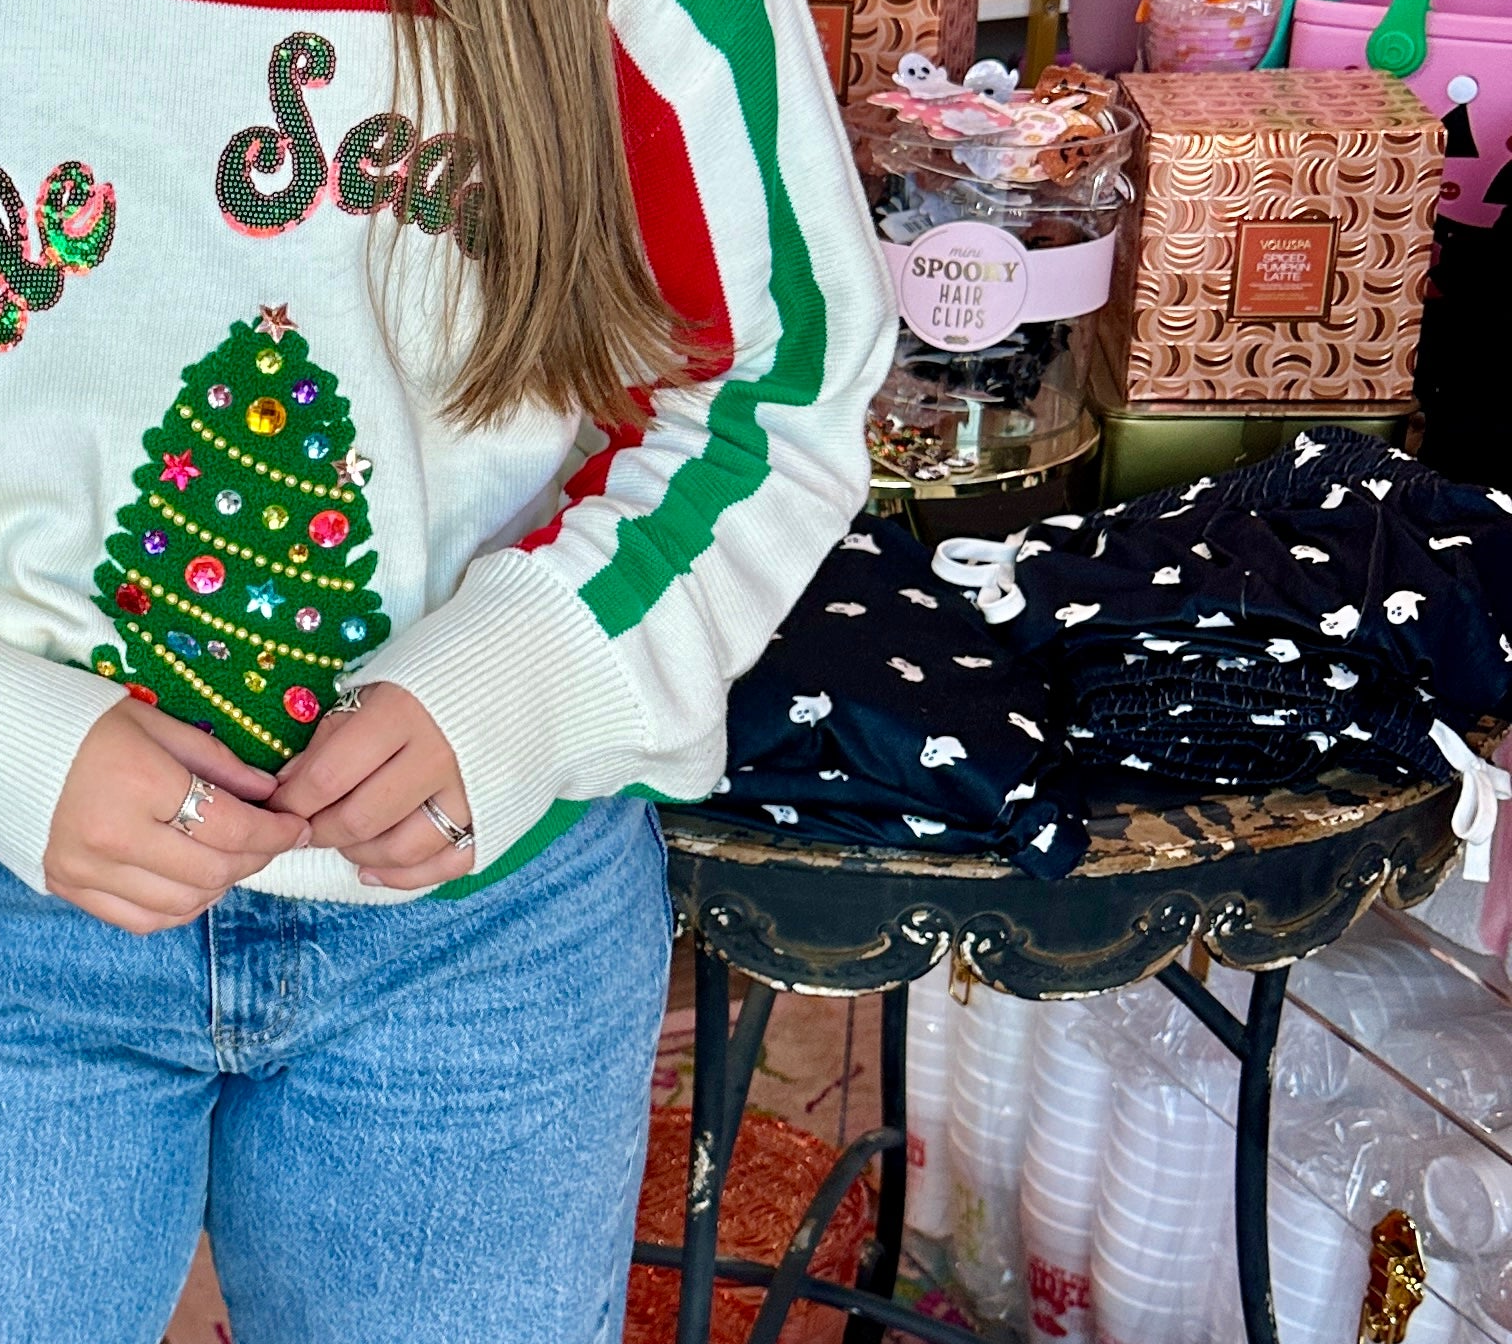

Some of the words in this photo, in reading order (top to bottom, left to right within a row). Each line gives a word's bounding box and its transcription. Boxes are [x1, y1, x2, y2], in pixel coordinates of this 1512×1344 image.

[214, 30, 488, 260] Sea
[1259, 239, 1312, 251] VOLUSPA
[948, 246, 983, 258] mini
[1262, 252, 1307, 263] SPICED
[1255, 263, 1312, 273] PUMPKIN
[1263, 272, 1302, 282] LATTE
[939, 283, 984, 306] HAIR
[932, 306, 986, 329] CLIPS
